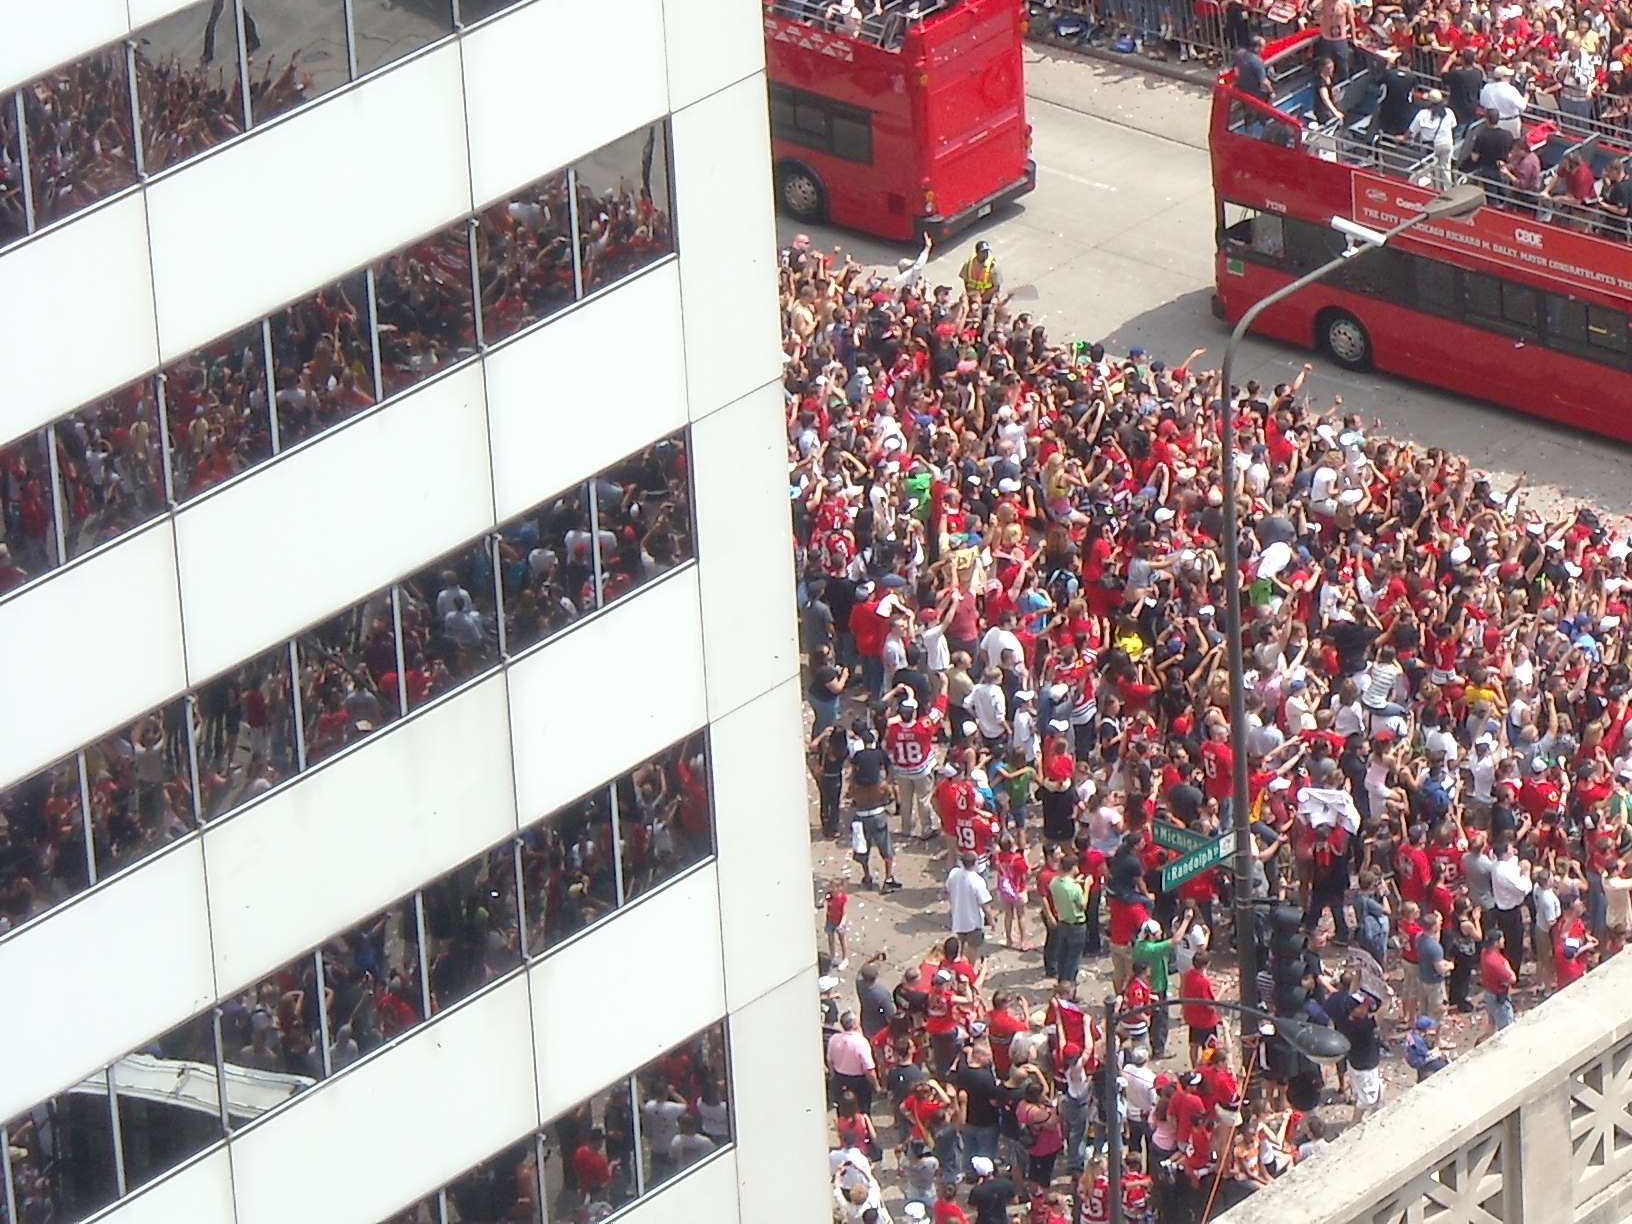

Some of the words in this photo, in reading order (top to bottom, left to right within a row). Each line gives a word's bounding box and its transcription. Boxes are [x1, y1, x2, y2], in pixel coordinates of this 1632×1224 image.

[1364, 207, 1379, 220] THE
[1380, 212, 1398, 225] CITY
[1520, 252, 1547, 267] MAYOR
[1549, 259, 1616, 286] CONGRATULATES
[1515, 228, 1543, 249] CBOE
[895, 741, 922, 765] 18
[956, 826, 976, 850] 19
[1171, 848, 1214, 881] Randolph
